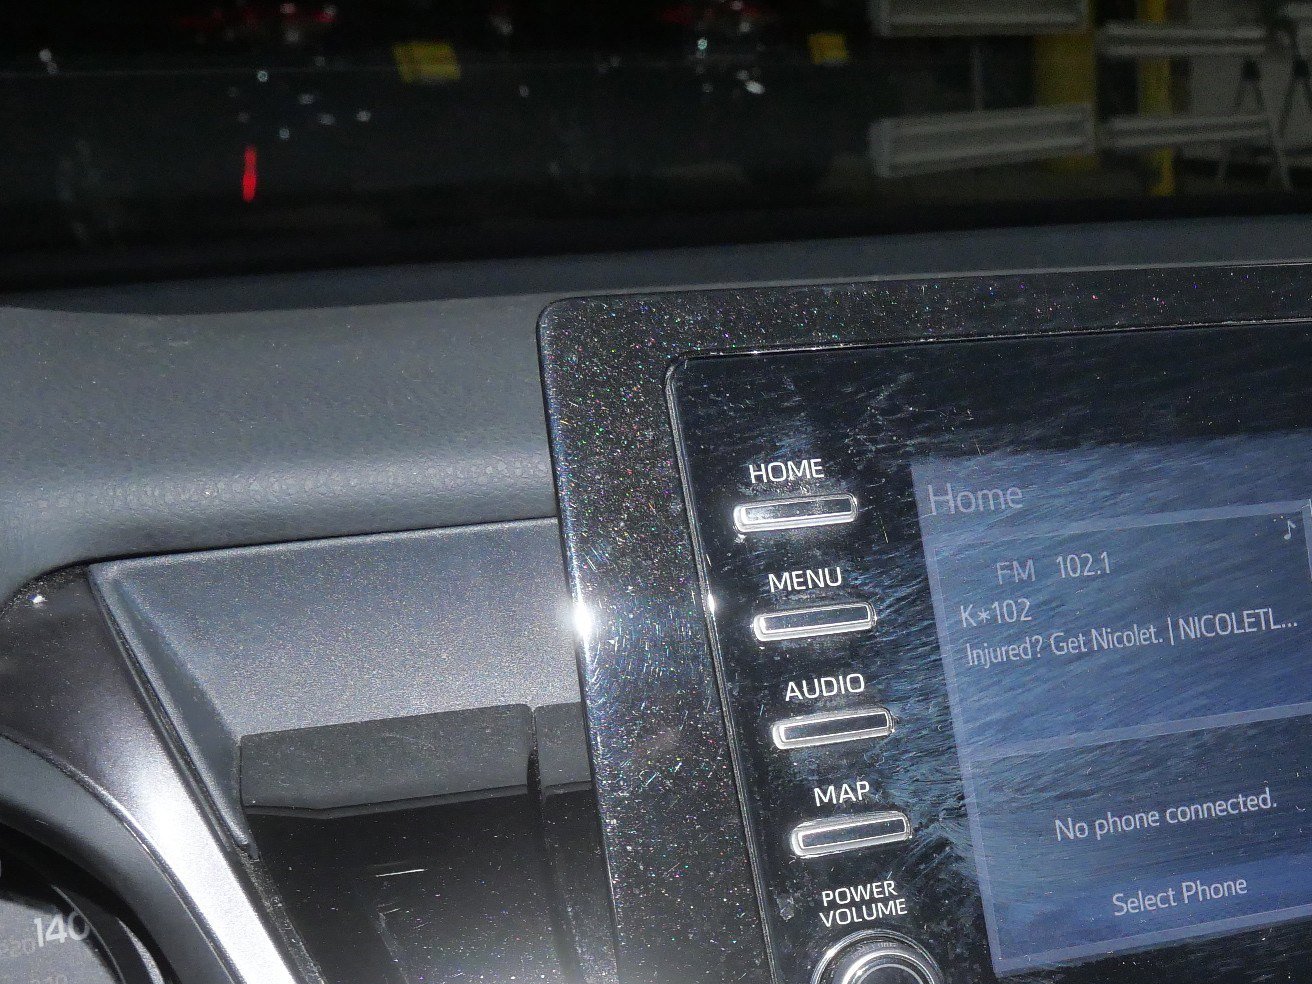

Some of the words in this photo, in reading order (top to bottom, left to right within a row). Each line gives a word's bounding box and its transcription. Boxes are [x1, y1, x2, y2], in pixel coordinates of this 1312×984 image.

[749, 458, 825, 484] HOME
[927, 483, 1024, 516] Home
[768, 566, 843, 593] MENU
[996, 559, 1036, 585] FM
[1055, 551, 1111, 579] 102.1
[965, 631, 1043, 668] Injured?
[1050, 631, 1088, 657] Get
[1090, 621, 1164, 651] Nicolet.
[785, 673, 865, 702] AUDIO
[814, 781, 870, 806] MAP
[1055, 818, 1088, 842] No
[1094, 810, 1160, 840] phone
[1165, 786, 1278, 825] connected.
[822, 880, 897, 907] POWER
[1112, 886, 1176, 917] Select
[1181, 876, 1248, 905] Phone
[820, 898, 908, 927] VOLUME
[33, 911, 91, 948] 140
